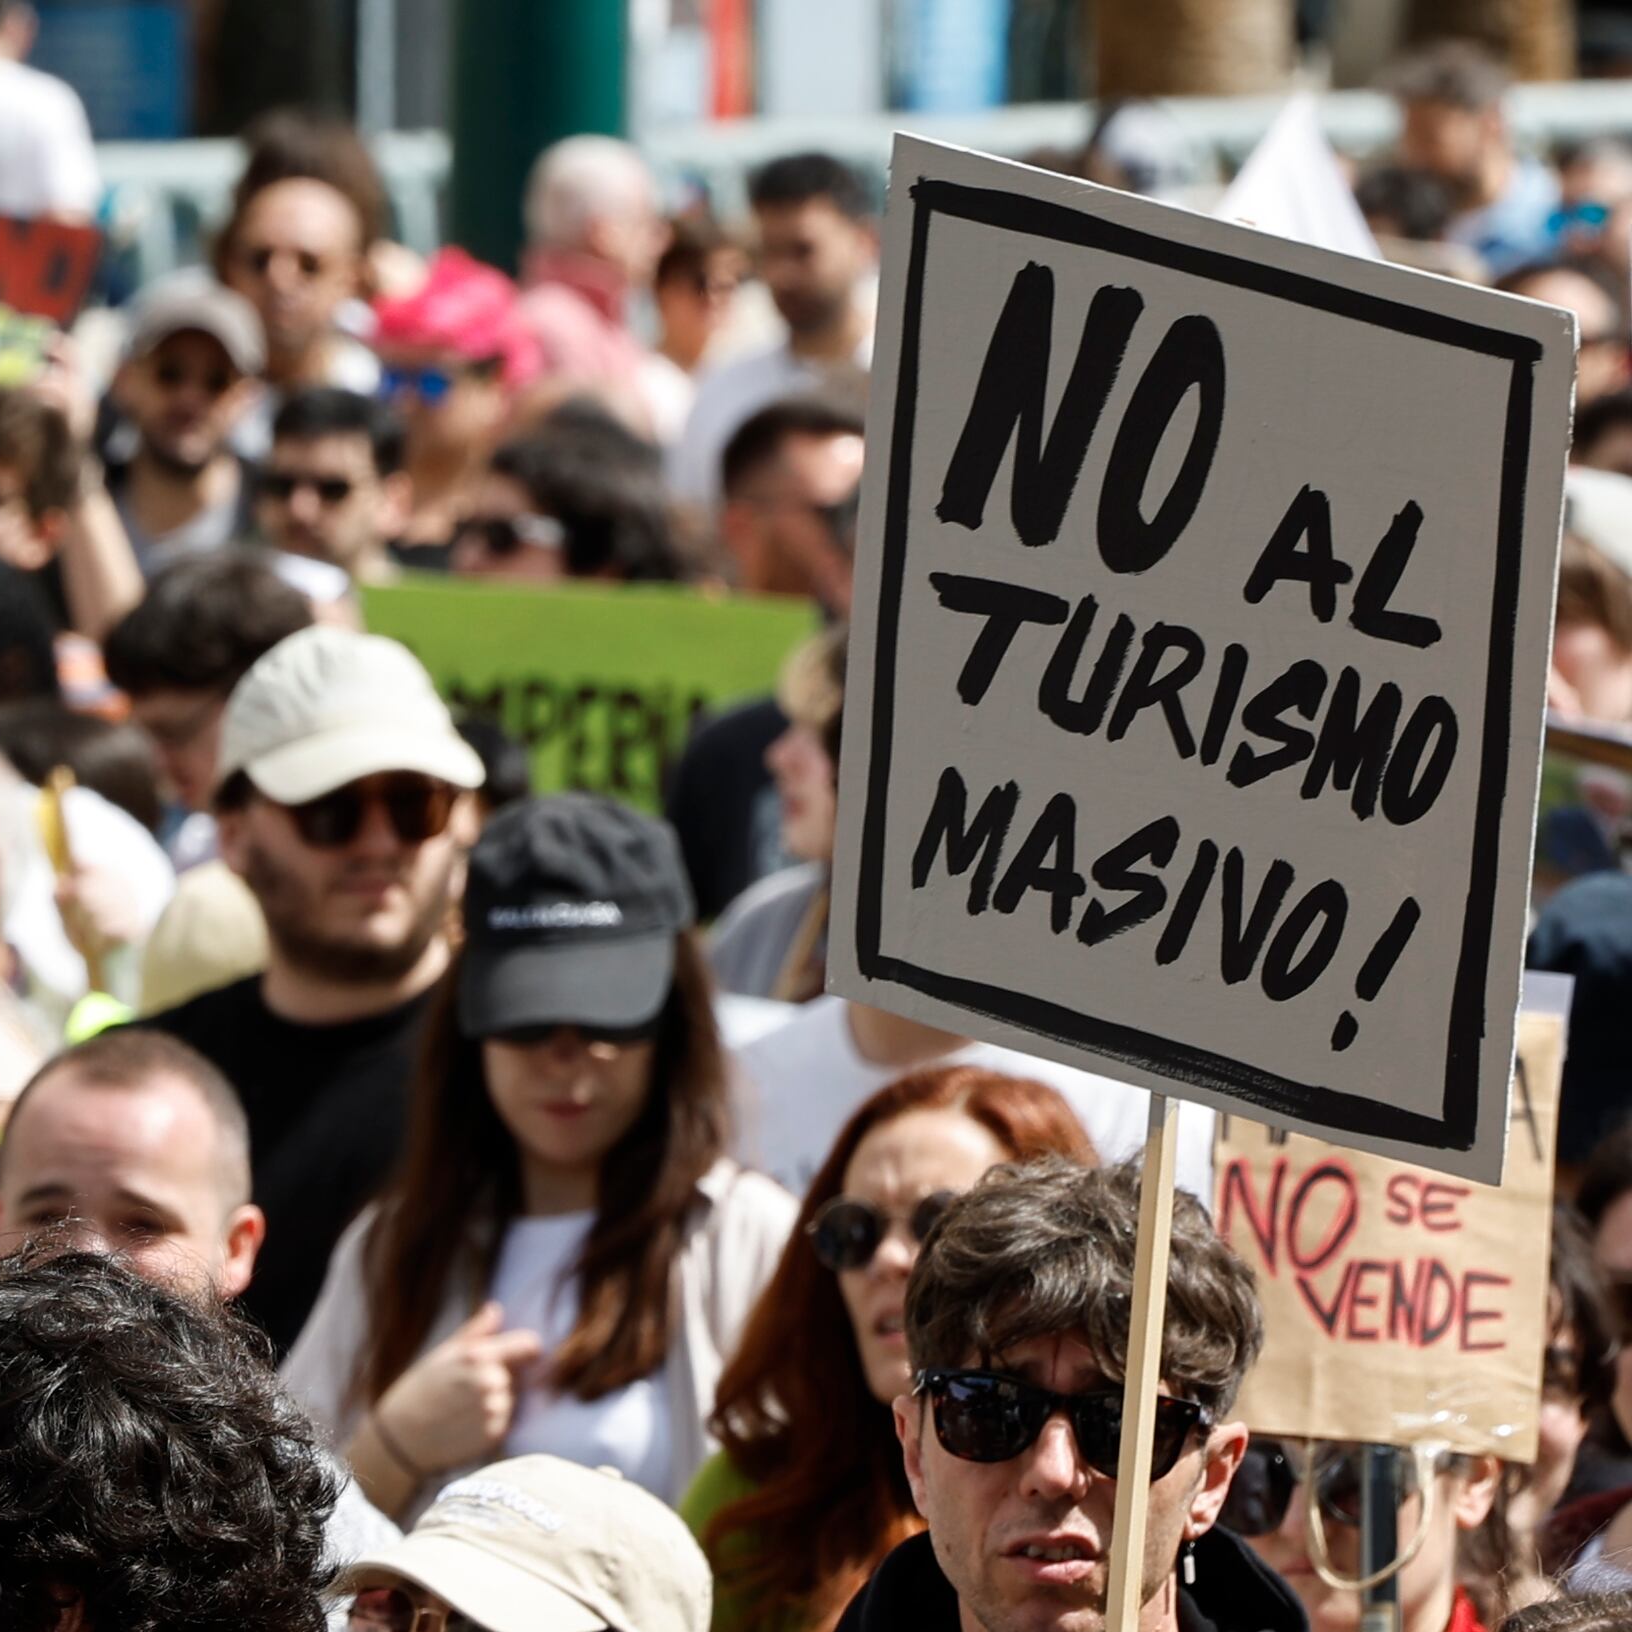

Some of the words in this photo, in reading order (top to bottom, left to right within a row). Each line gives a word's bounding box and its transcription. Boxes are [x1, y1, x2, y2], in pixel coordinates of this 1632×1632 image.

[936, 261, 1225, 574] NO
[1244, 484, 1441, 648] AL
[929, 572, 1458, 825] TURISMO
[911, 767, 1421, 1051] MASIVO!
[1216, 1157, 1360, 1278] NO
[1385, 1174, 1472, 1235] SE
[1295, 1256, 1513, 1356] VENDE
